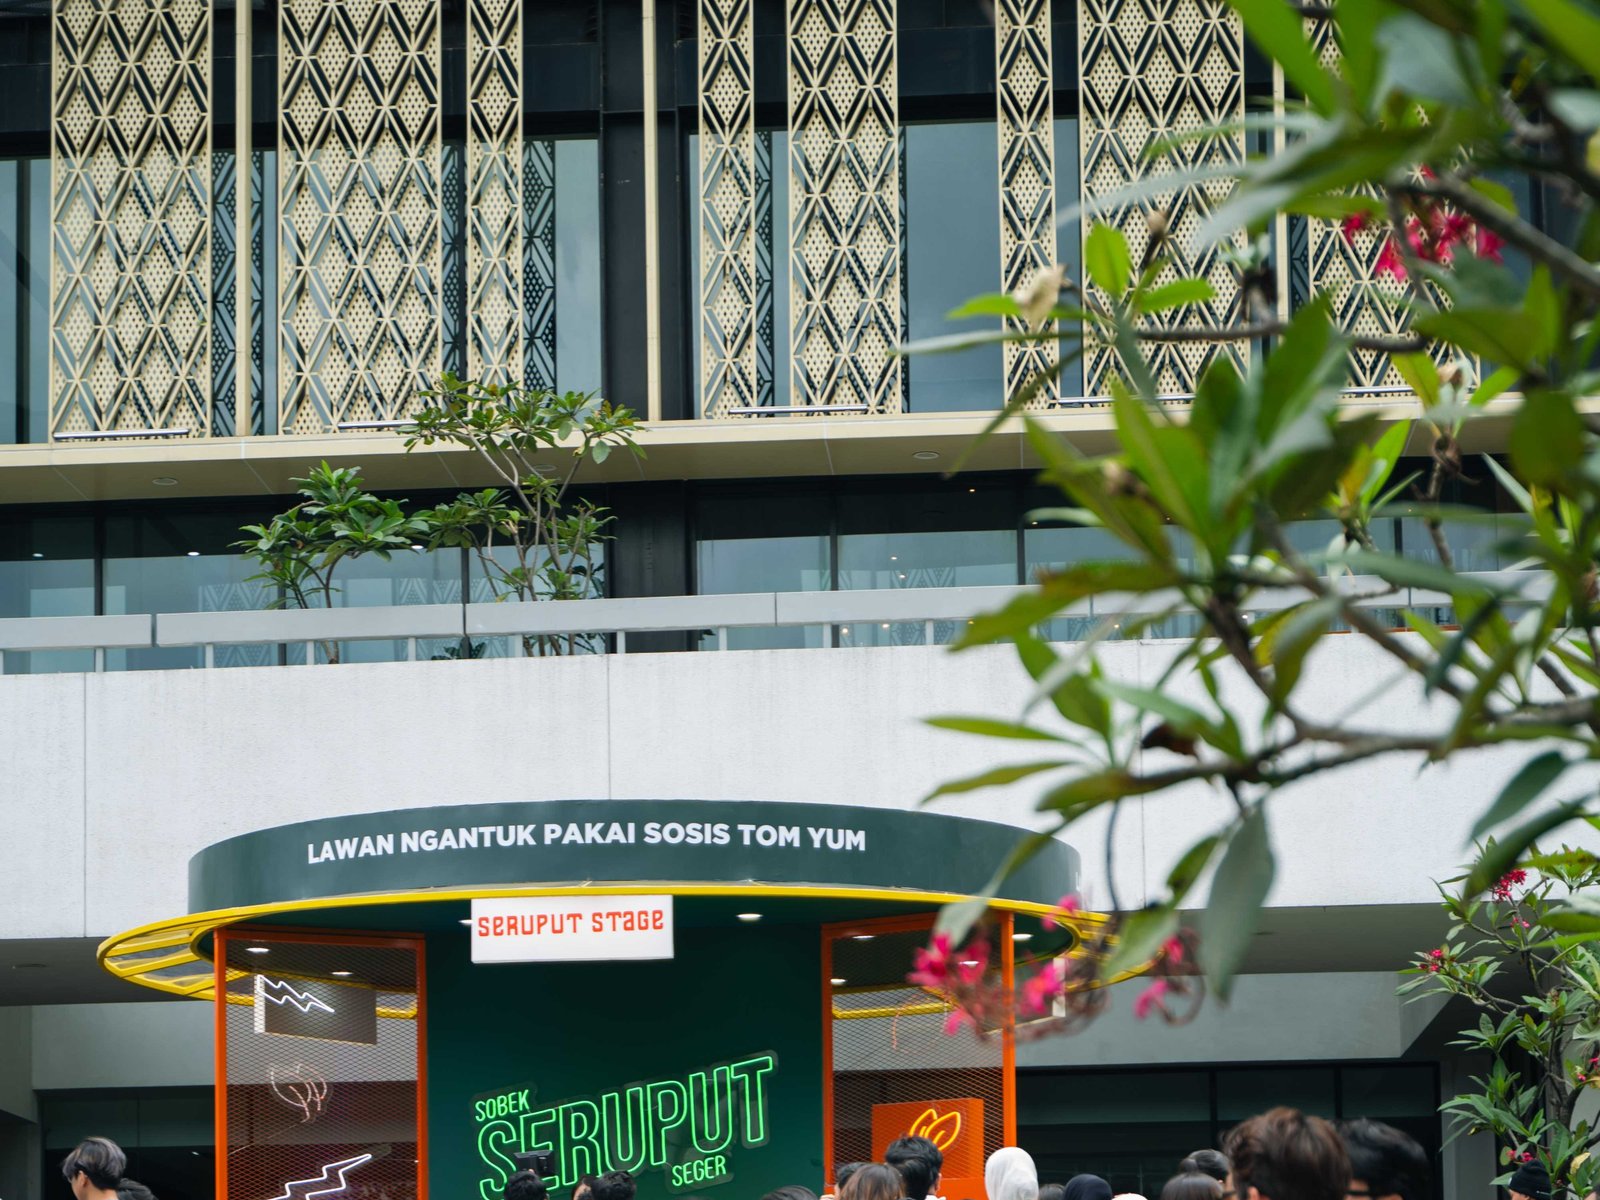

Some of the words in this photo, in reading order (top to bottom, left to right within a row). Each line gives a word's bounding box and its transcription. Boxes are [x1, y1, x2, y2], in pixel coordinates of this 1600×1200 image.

[307, 833, 394, 865] LAWAN
[400, 824, 537, 854] NGANTUK
[543, 822, 636, 845] PAKAI
[643, 822, 731, 845] SOSIS
[737, 824, 801, 848] TOM
[806, 827, 866, 852] YUM
[474, 1089, 530, 1122] SOBEK
[671, 1155, 727, 1187] SEGER
